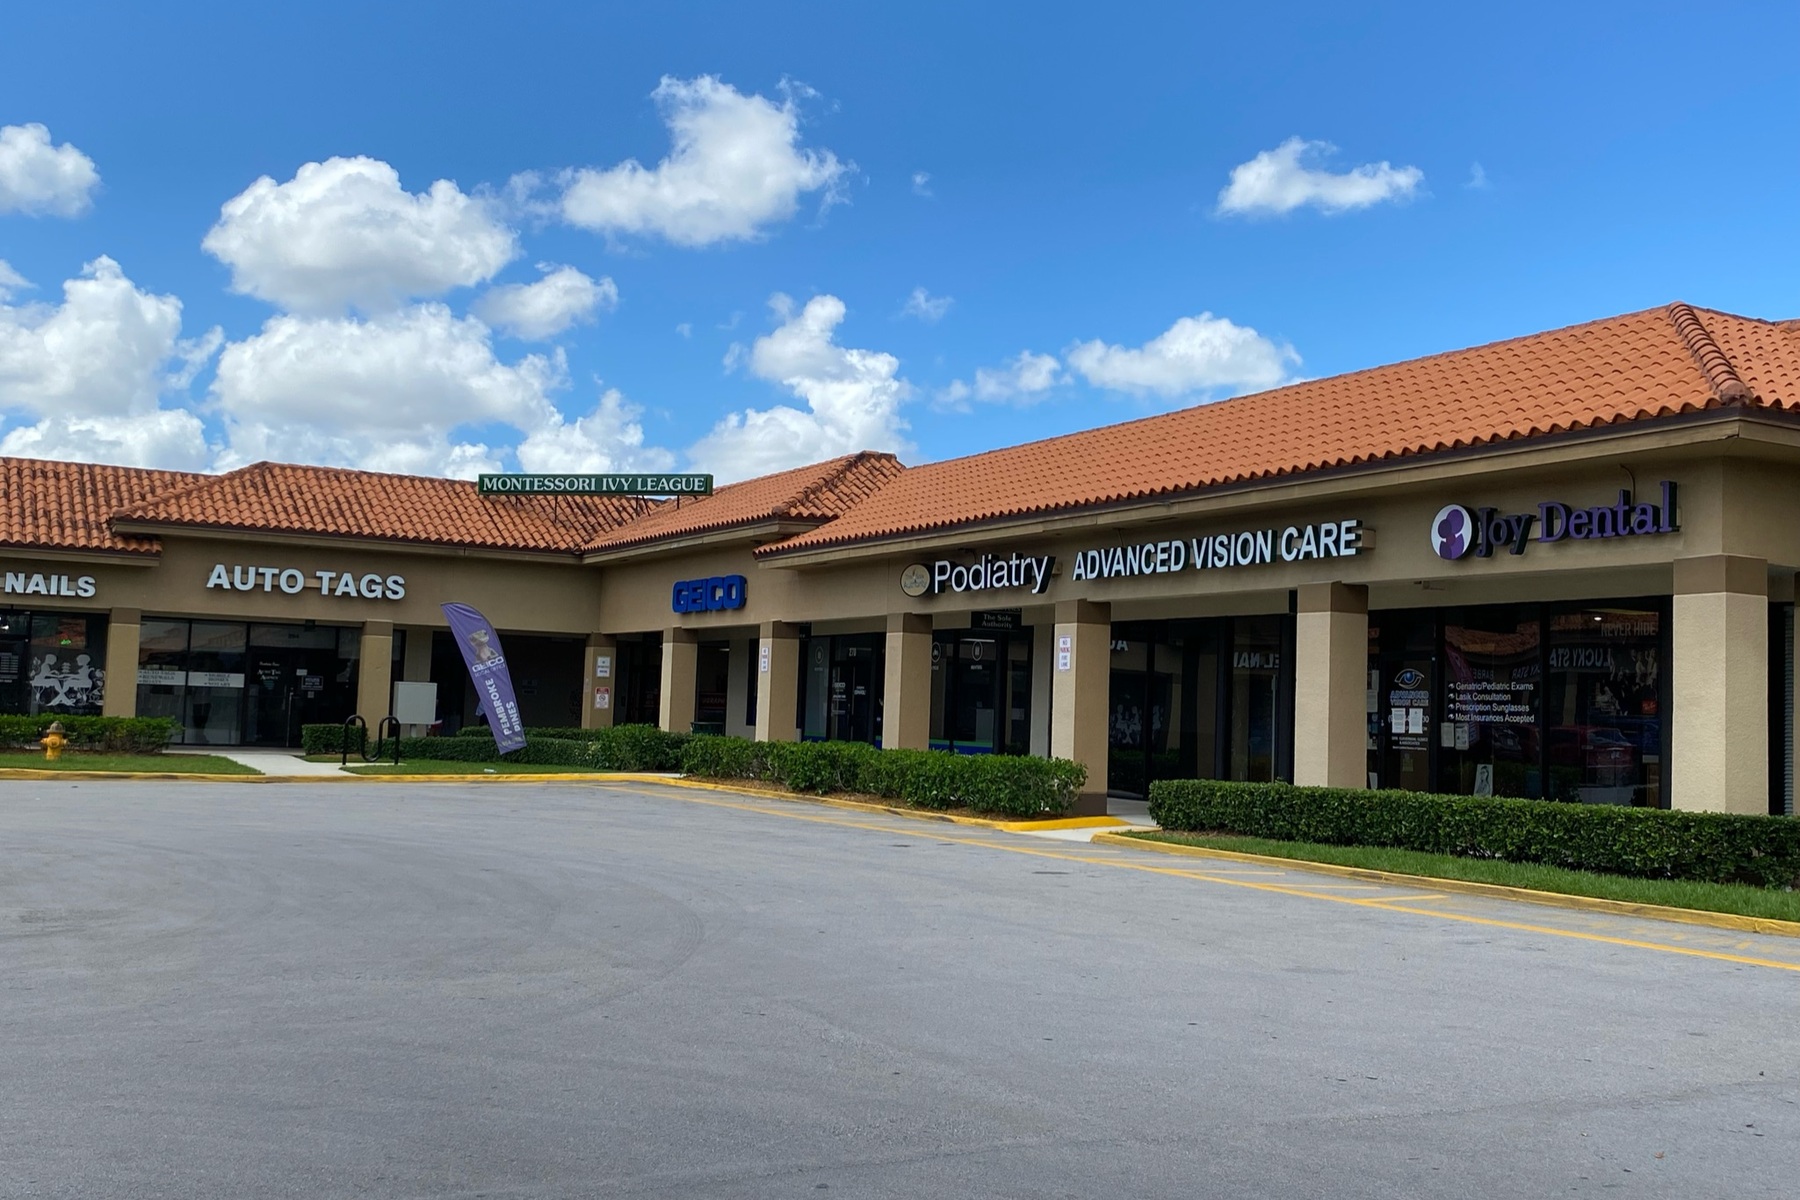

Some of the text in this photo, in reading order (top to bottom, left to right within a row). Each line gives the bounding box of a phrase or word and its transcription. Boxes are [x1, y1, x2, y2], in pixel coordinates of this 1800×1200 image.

[483, 477, 705, 491] MONTESSORI IVY LEAGUE
[1476, 481, 1676, 557] Joy Dental
[1072, 519, 1360, 581] ADVANCED VISION CARE
[934, 553, 1051, 594] Podiatry
[4, 572, 96, 598] NAILS
[206, 564, 406, 600] AUTO TAGS
[673, 575, 746, 613] GEICO
[982, 621, 1012, 630] Authority
[983, 613, 1012, 622] The Sole
[1601, 621, 1656, 637] NEVER HIDE
[472, 656, 504, 672] GEICO
[1390, 690, 1429, 699] ADVANCED
[1455, 682, 1534, 691] Geriatric/Pediatric Exams
[1390, 699, 1429, 707] VISION CARE
[1455, 692, 1512, 701] Lasik Consultation
[485, 678, 512, 735] PEMBROKE
[1455, 702, 1530, 713] Prescription Sunglasses
[506, 701, 521, 732] PINES
[1455, 713, 1535, 724] Most Insurances Accepted
